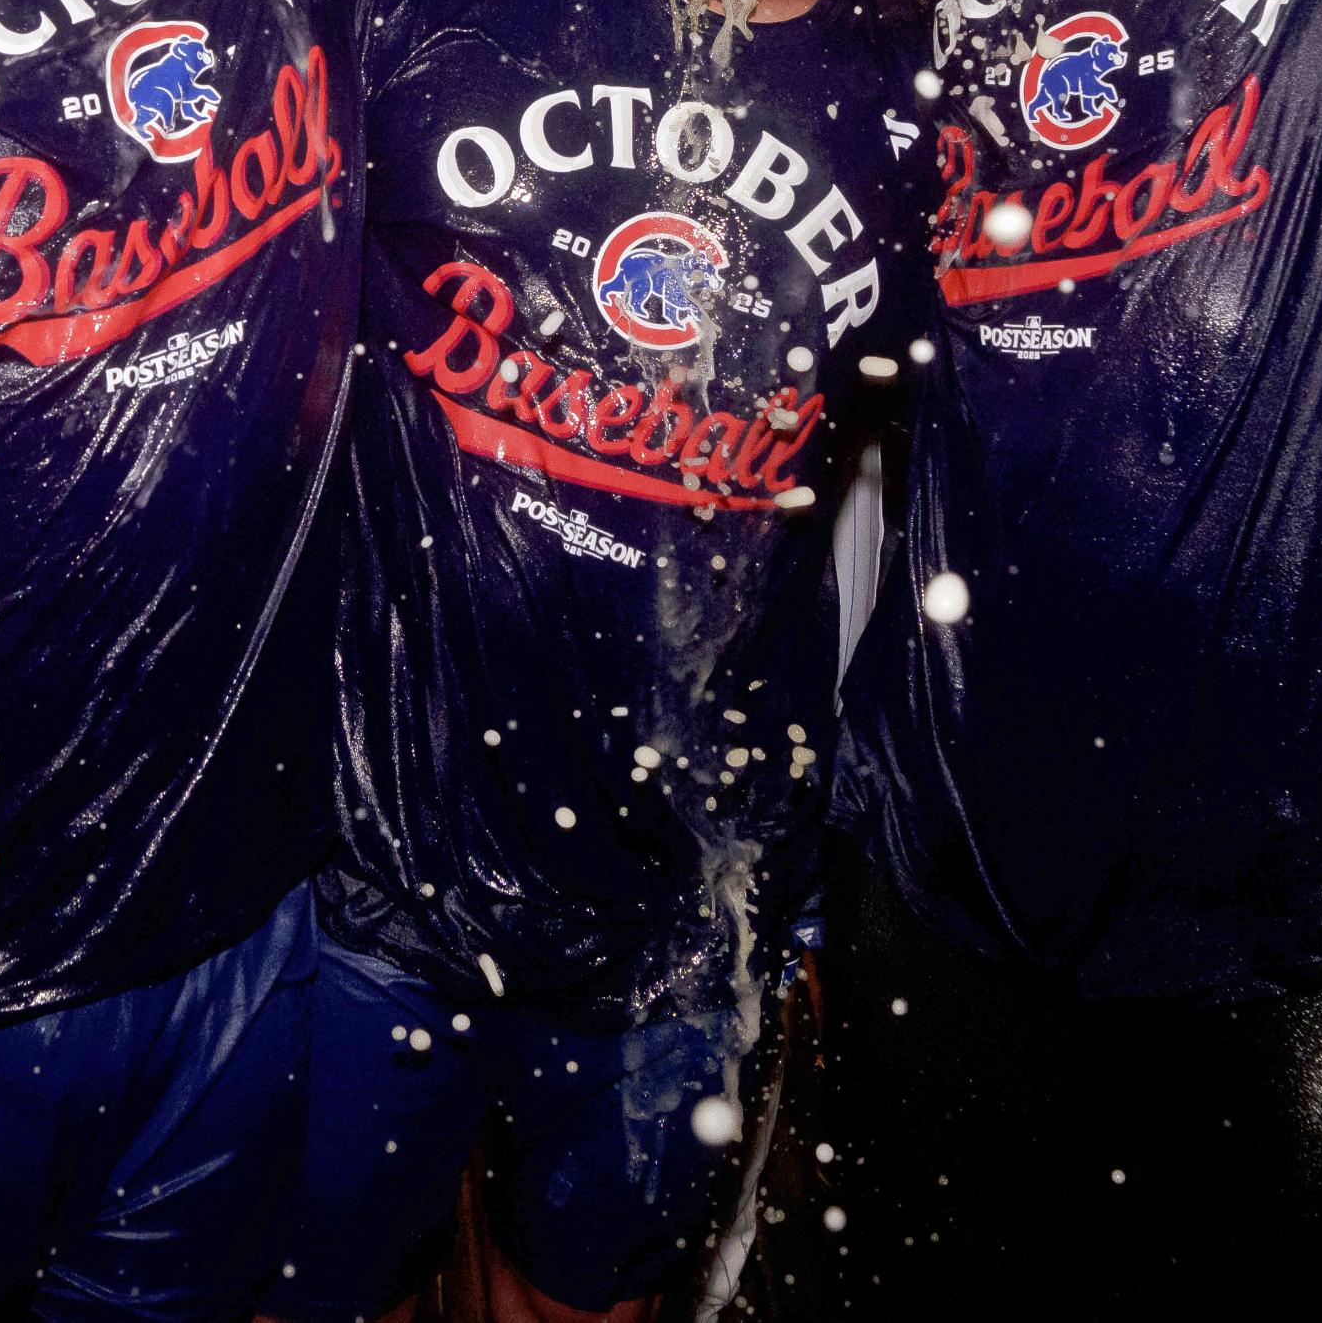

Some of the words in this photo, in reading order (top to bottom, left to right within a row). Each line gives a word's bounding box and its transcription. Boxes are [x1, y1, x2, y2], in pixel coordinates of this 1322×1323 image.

[1139, 49, 1175, 76] 25
[62, 93, 103, 120] 20
[437, 83, 880, 349] OCTOBER
[552, 228, 591, 259] 20
[736, 294, 773, 319] 25
[105, 319, 248, 394] POSTSEASON
[980, 324, 1093, 351] POSTSEASON
[1017, 349, 1041, 360] 2025
[403, 261, 826, 493] Baseball
[511, 493, 642, 568] POSSEASON
